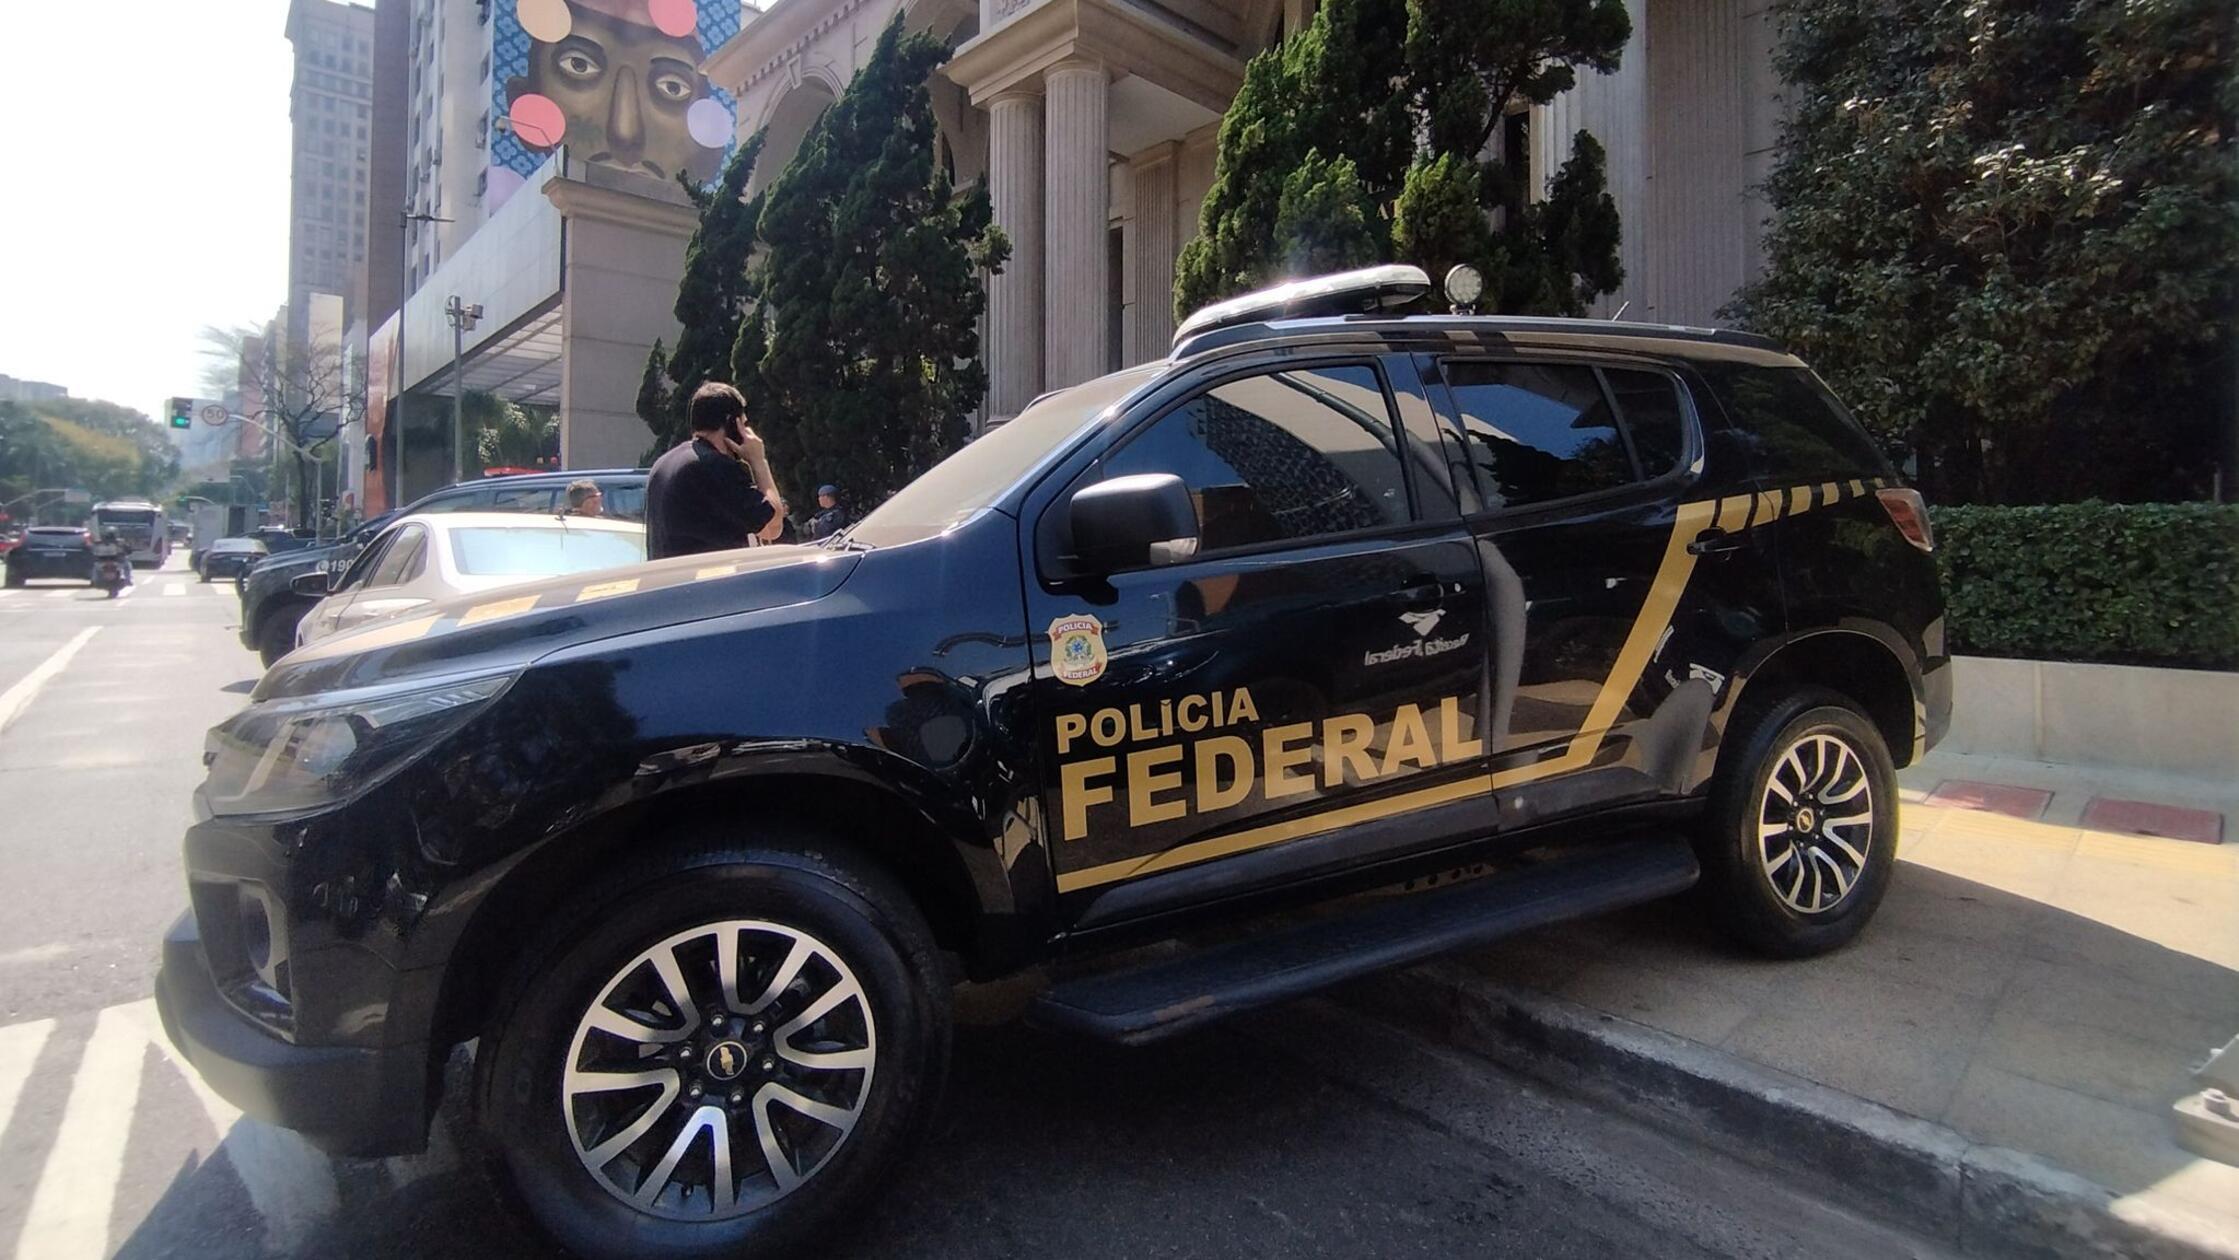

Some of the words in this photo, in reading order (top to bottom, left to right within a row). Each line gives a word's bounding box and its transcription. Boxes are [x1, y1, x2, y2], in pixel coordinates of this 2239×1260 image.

[208, 409, 225, 419] 50
[1063, 667, 1097, 678] FEDERAL
[1055, 687, 1259, 754] POLÍCIA
[1060, 696, 1482, 842] FEDERAL
